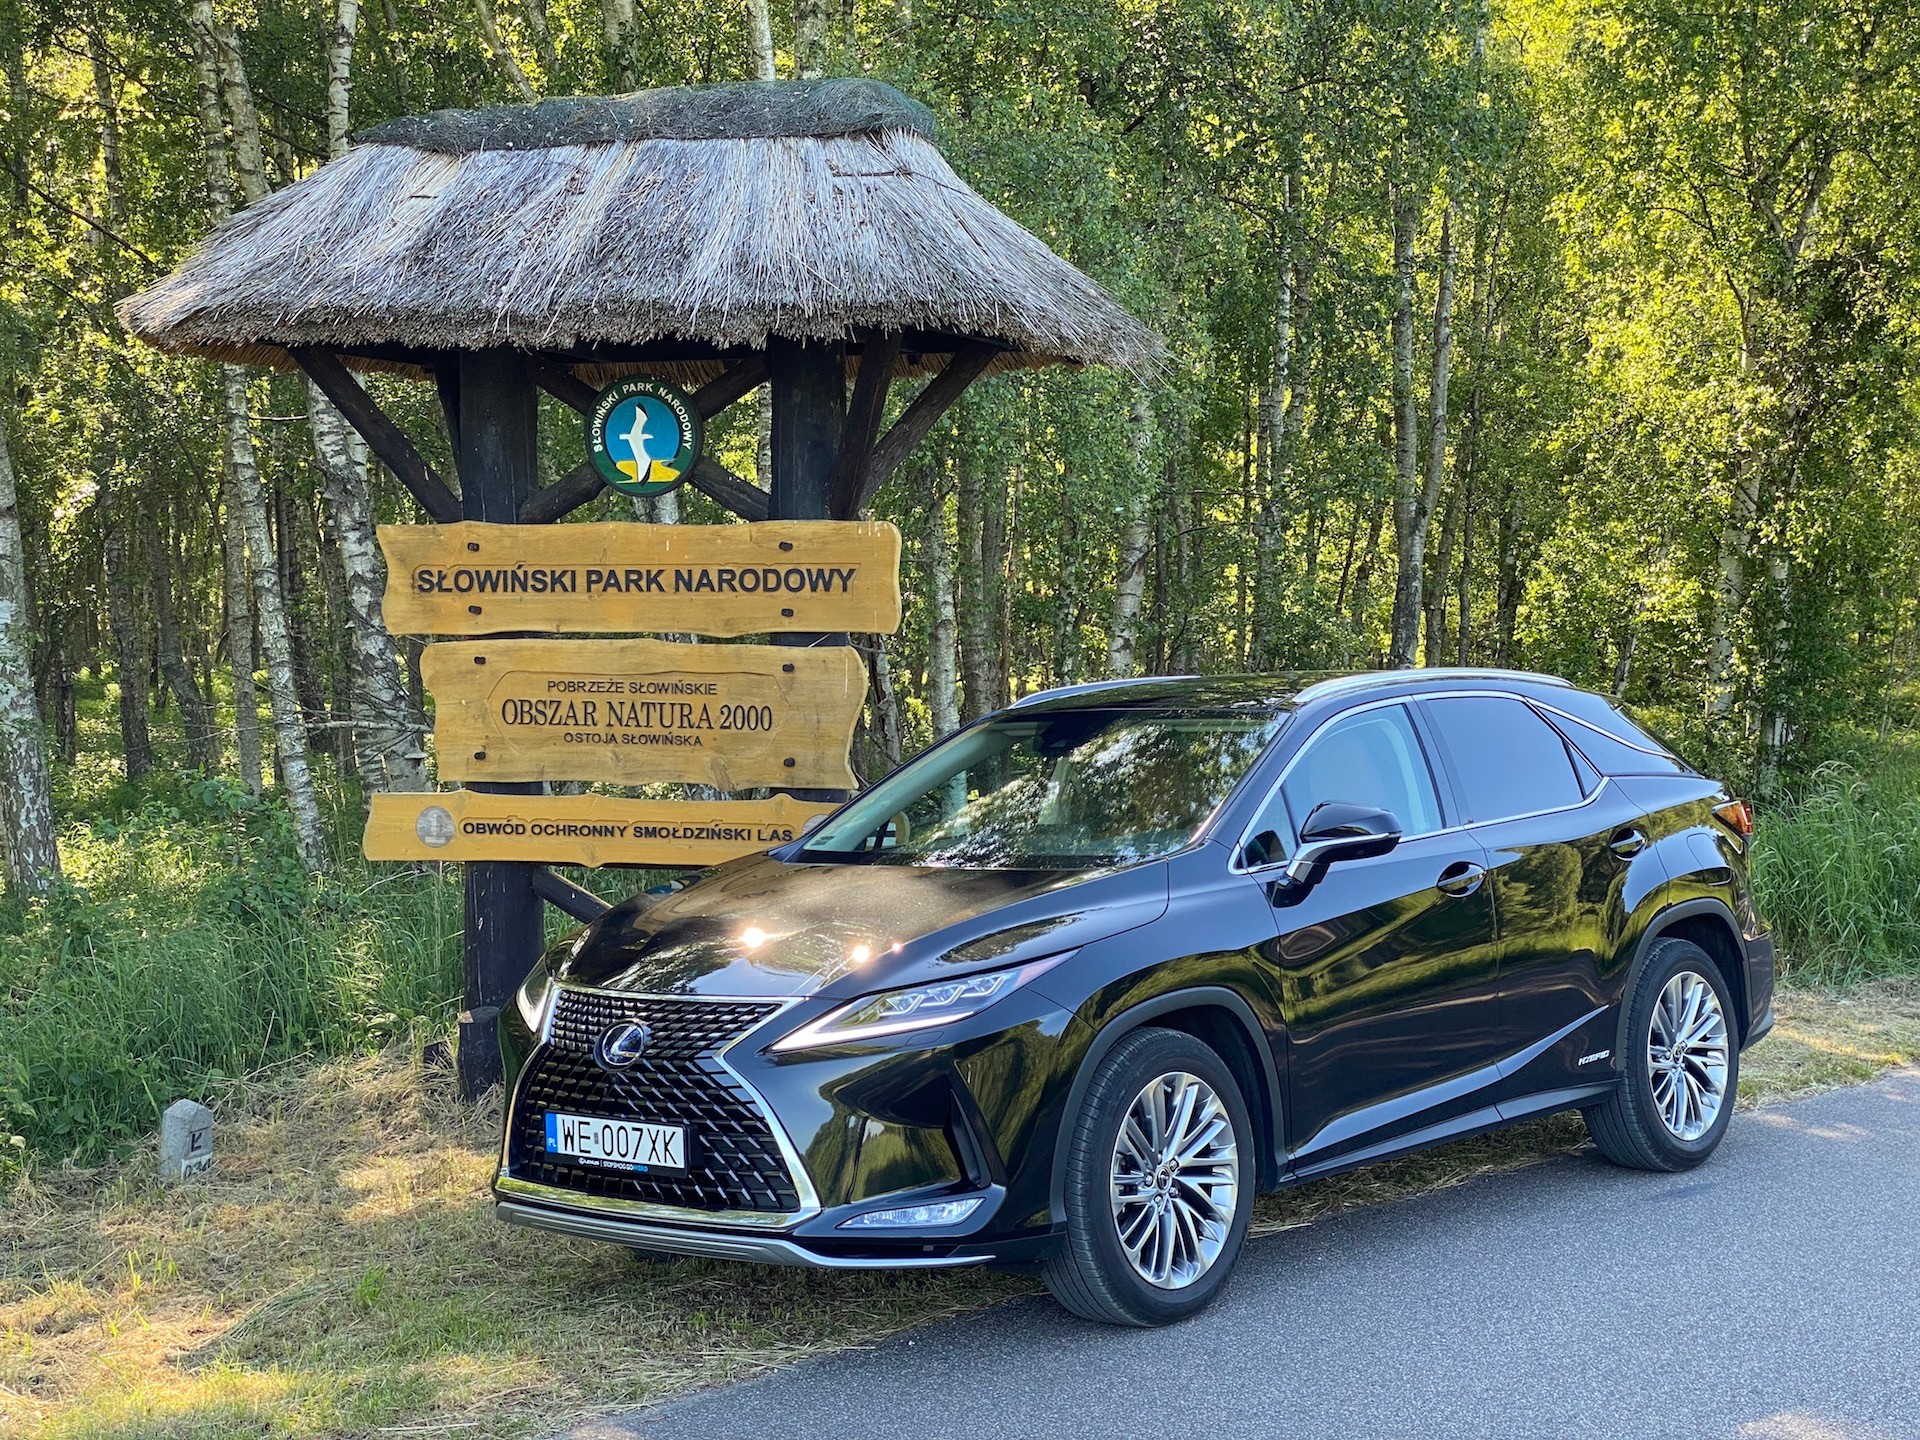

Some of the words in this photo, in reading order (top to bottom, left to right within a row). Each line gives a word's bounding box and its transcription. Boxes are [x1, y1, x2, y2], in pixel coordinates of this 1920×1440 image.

[591, 390, 619, 453] SŁOWIŃSKI
[622, 382, 654, 395] PARK
[657, 387, 693, 450] NARODOWY
[417, 563, 577, 594] SŁOWIŃSKI
[586, 569, 666, 594] PARK
[674, 568, 857, 594] NARODOWY
[547, 678, 625, 694] POBRZEŻE
[629, 680, 718, 696] SŁOWIŃSKIE
[501, 698, 598, 727] OBSZAR
[606, 700, 715, 730] NATURA
[719, 704, 773, 731] 2000
[563, 732, 618, 745] OSTOJA
[621, 731, 704, 747] SŁOWIŃSKA
[463, 819, 527, 836] OBWÓD
[531, 823, 628, 838] OCHRONNY
[633, 823, 752, 842] SMOŁDZIŃSKI
[757, 829, 794, 843] LAS
[548, 1137, 557, 1148] PL
[562, 1119, 591, 1154] WE
[602, 1124, 677, 1165] 007XK
